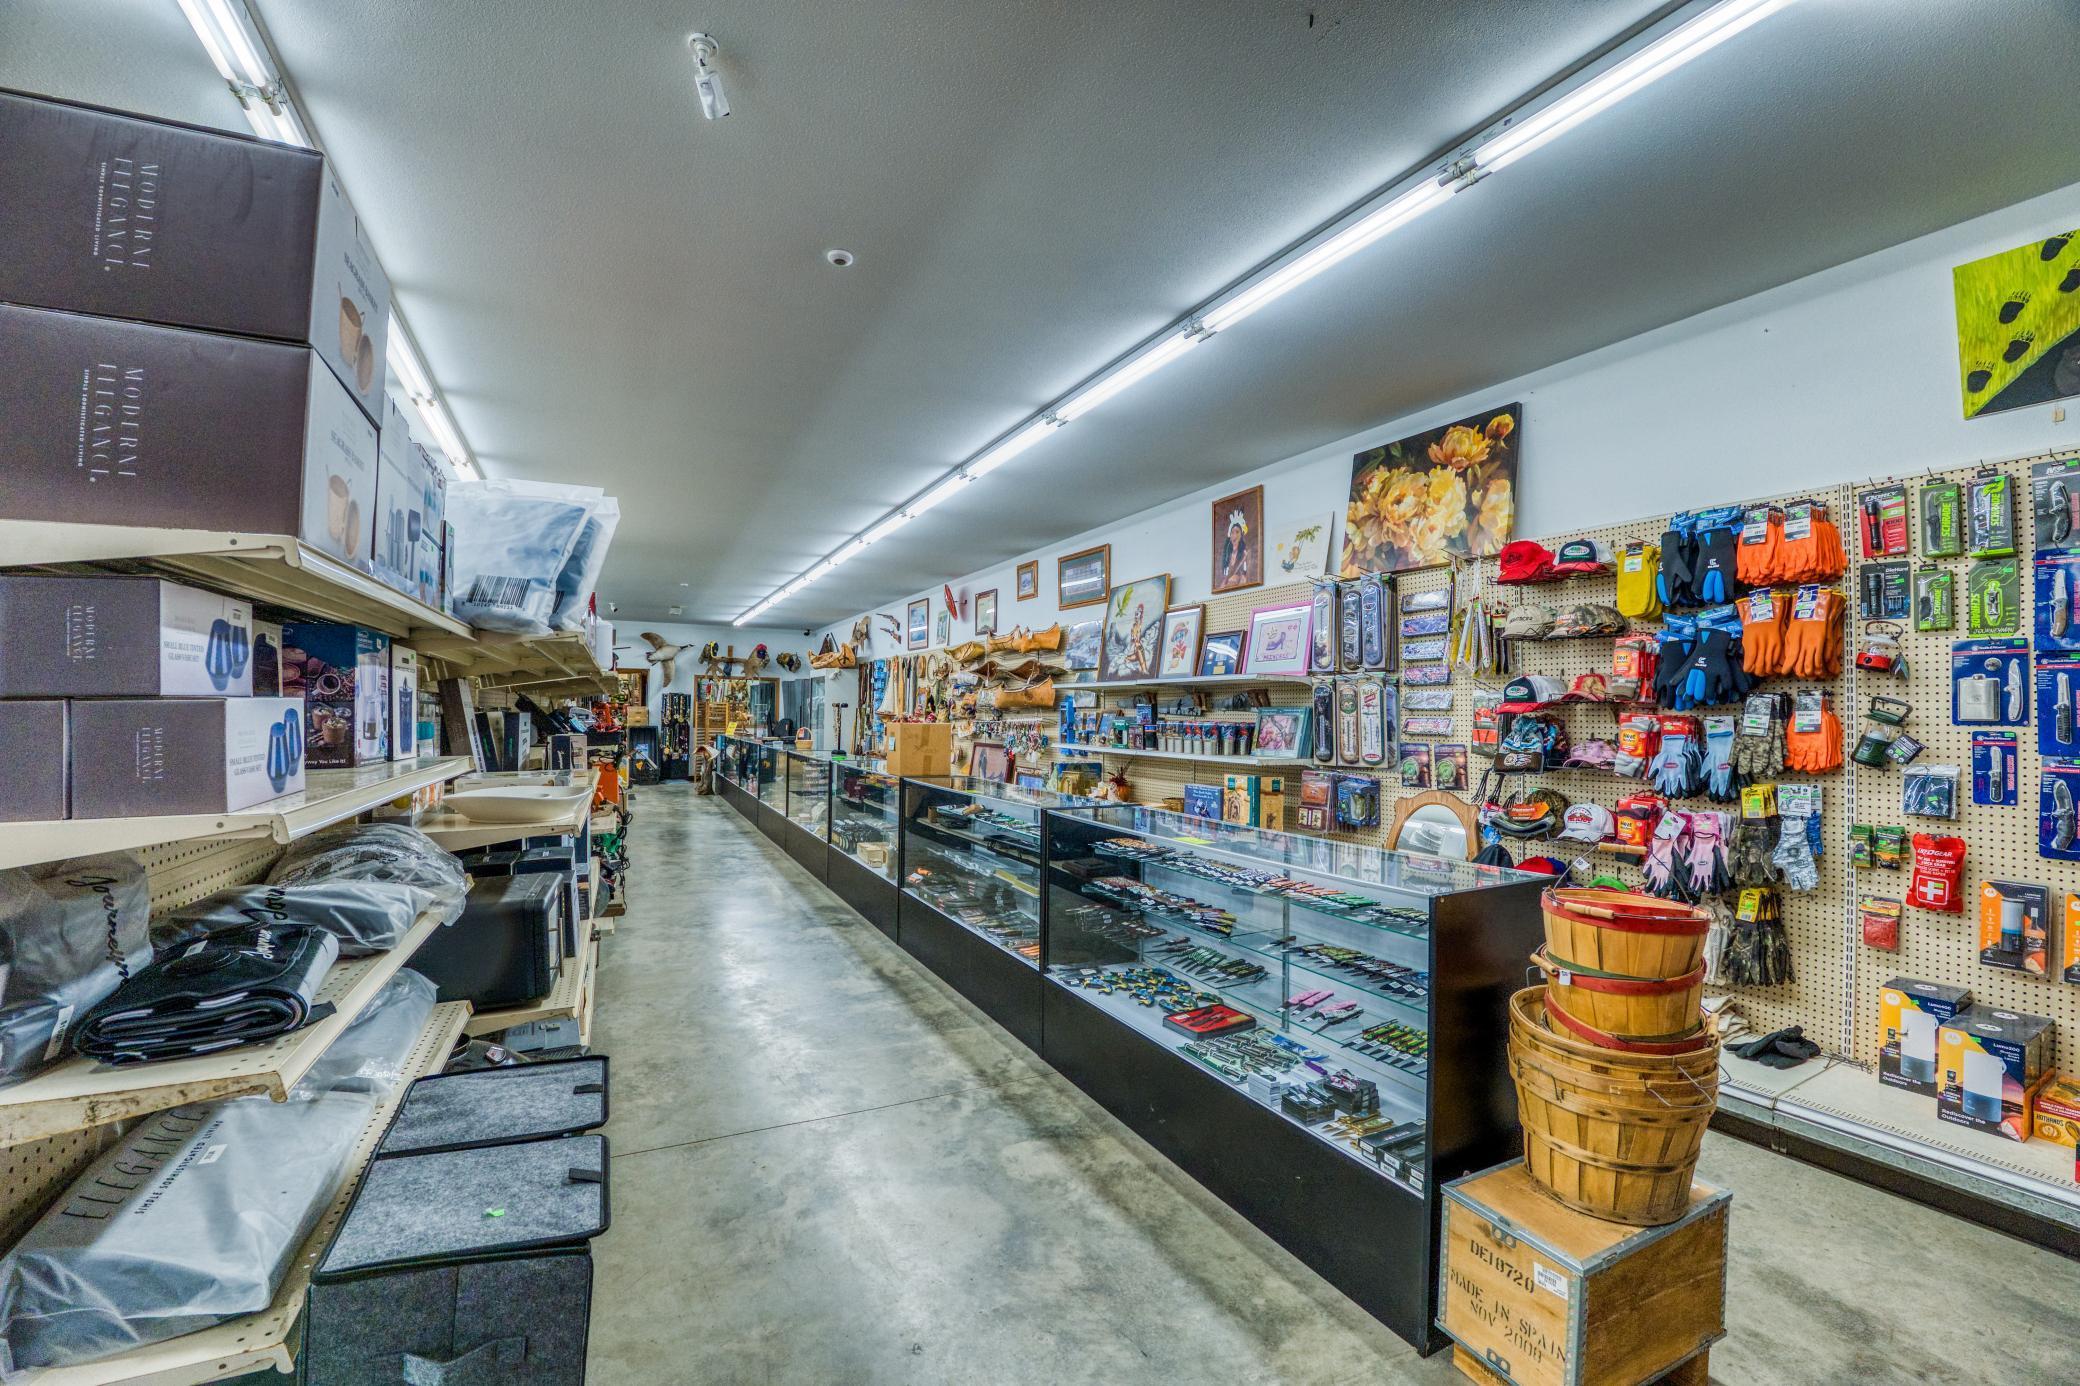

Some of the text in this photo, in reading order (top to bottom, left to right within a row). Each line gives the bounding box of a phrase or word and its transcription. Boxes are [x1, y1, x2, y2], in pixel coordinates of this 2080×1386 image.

[105, 157, 132, 264] ELEGANCE
[132, 165, 159, 268] MODERN
[90, 363, 117, 473] ELEGANCE
[118, 367, 144, 476] MODERN
[1971, 592, 1981, 629] SCHRADE
[1941, 1108, 1974, 1121] Rediscover
[1941, 1114, 1970, 1125] Outdoors
[2036, 1114, 2064, 1126] HOTHANDS
[60, 1109, 210, 1220] ELEGANCE
[134, 1120, 224, 1215] SIMPLE SOPHISTICATED LIVING
[1450, 1268, 1566, 1362] MADE IN SPAIN
[1470, 1299, 1496, 1328] NOV
